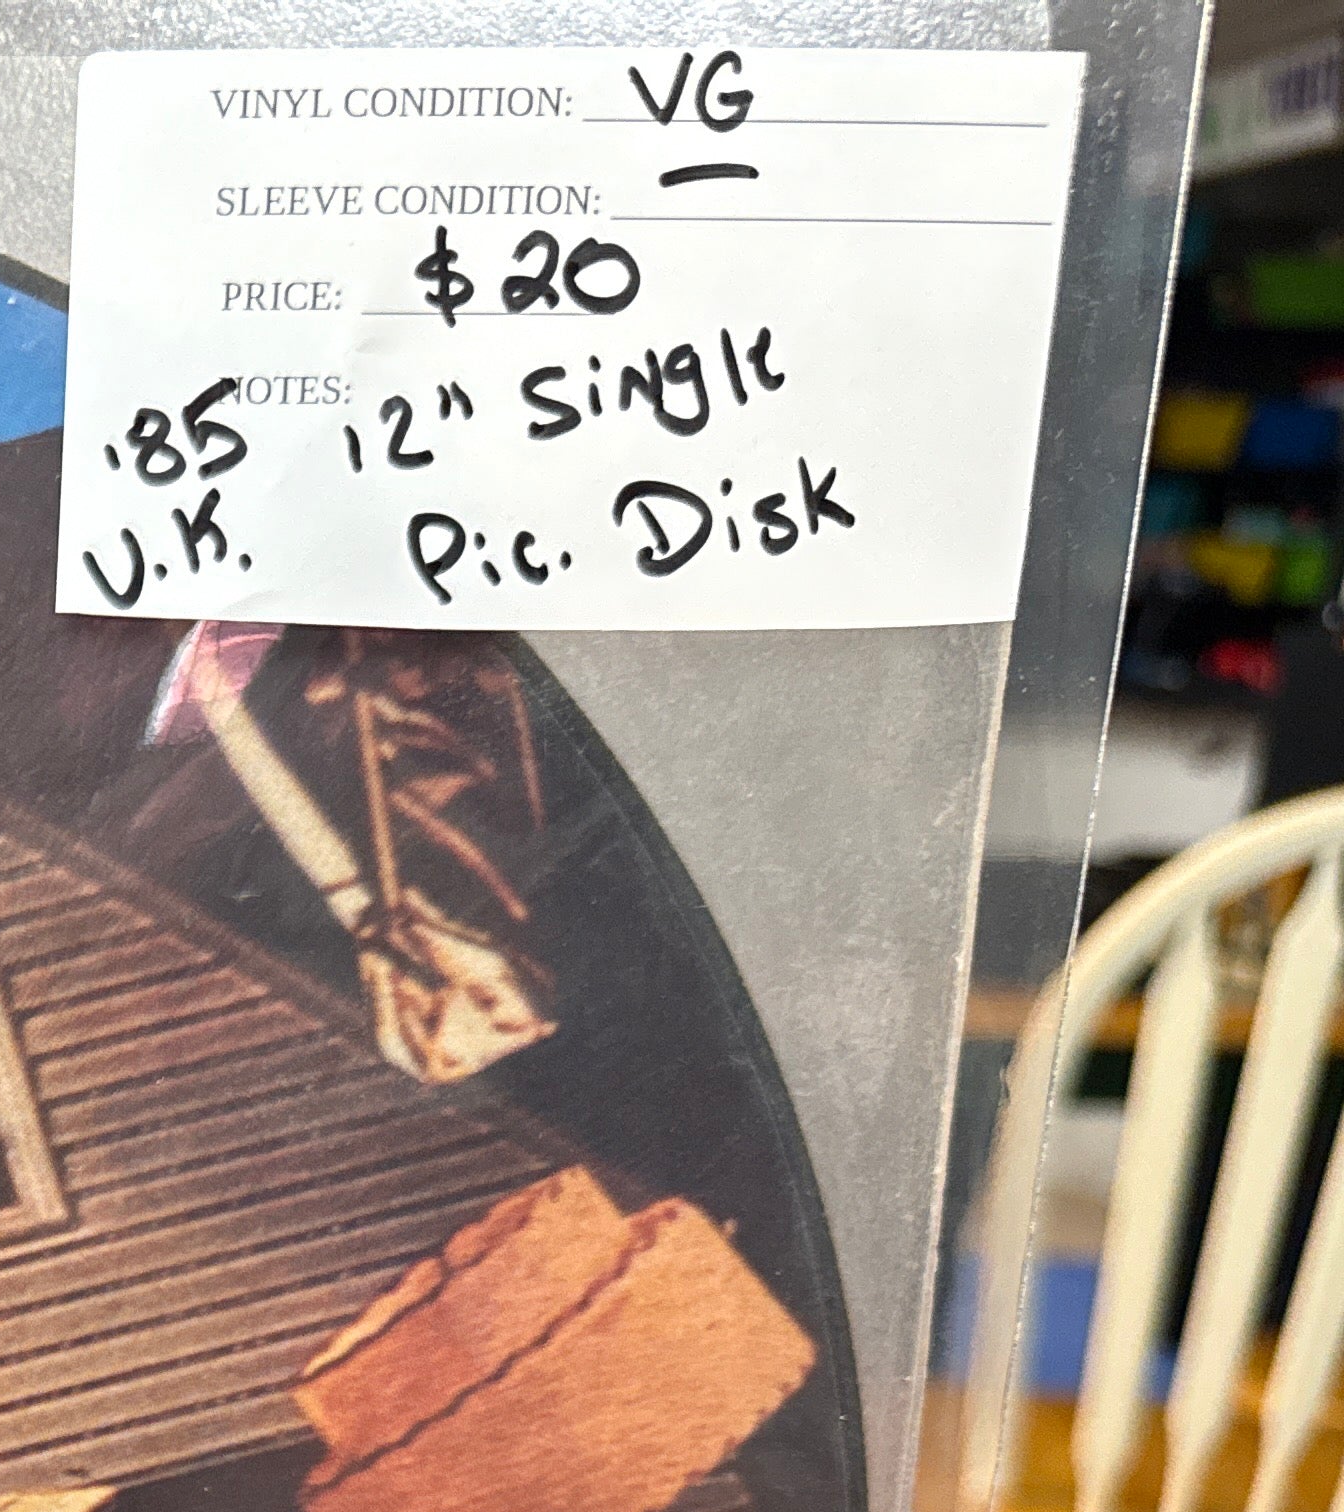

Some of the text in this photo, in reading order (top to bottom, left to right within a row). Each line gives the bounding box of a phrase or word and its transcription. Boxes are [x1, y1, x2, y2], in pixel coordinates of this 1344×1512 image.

[211, 84, 575, 120] VINYL CONDITION:
[628, 50, 756, 131] VG
[215, 183, 603, 219] SLEEVE CONDITION:
[220, 279, 344, 314] PRICE:
[406, 512, 572, 605] Pic.
[613, 456, 857, 579] Disk
